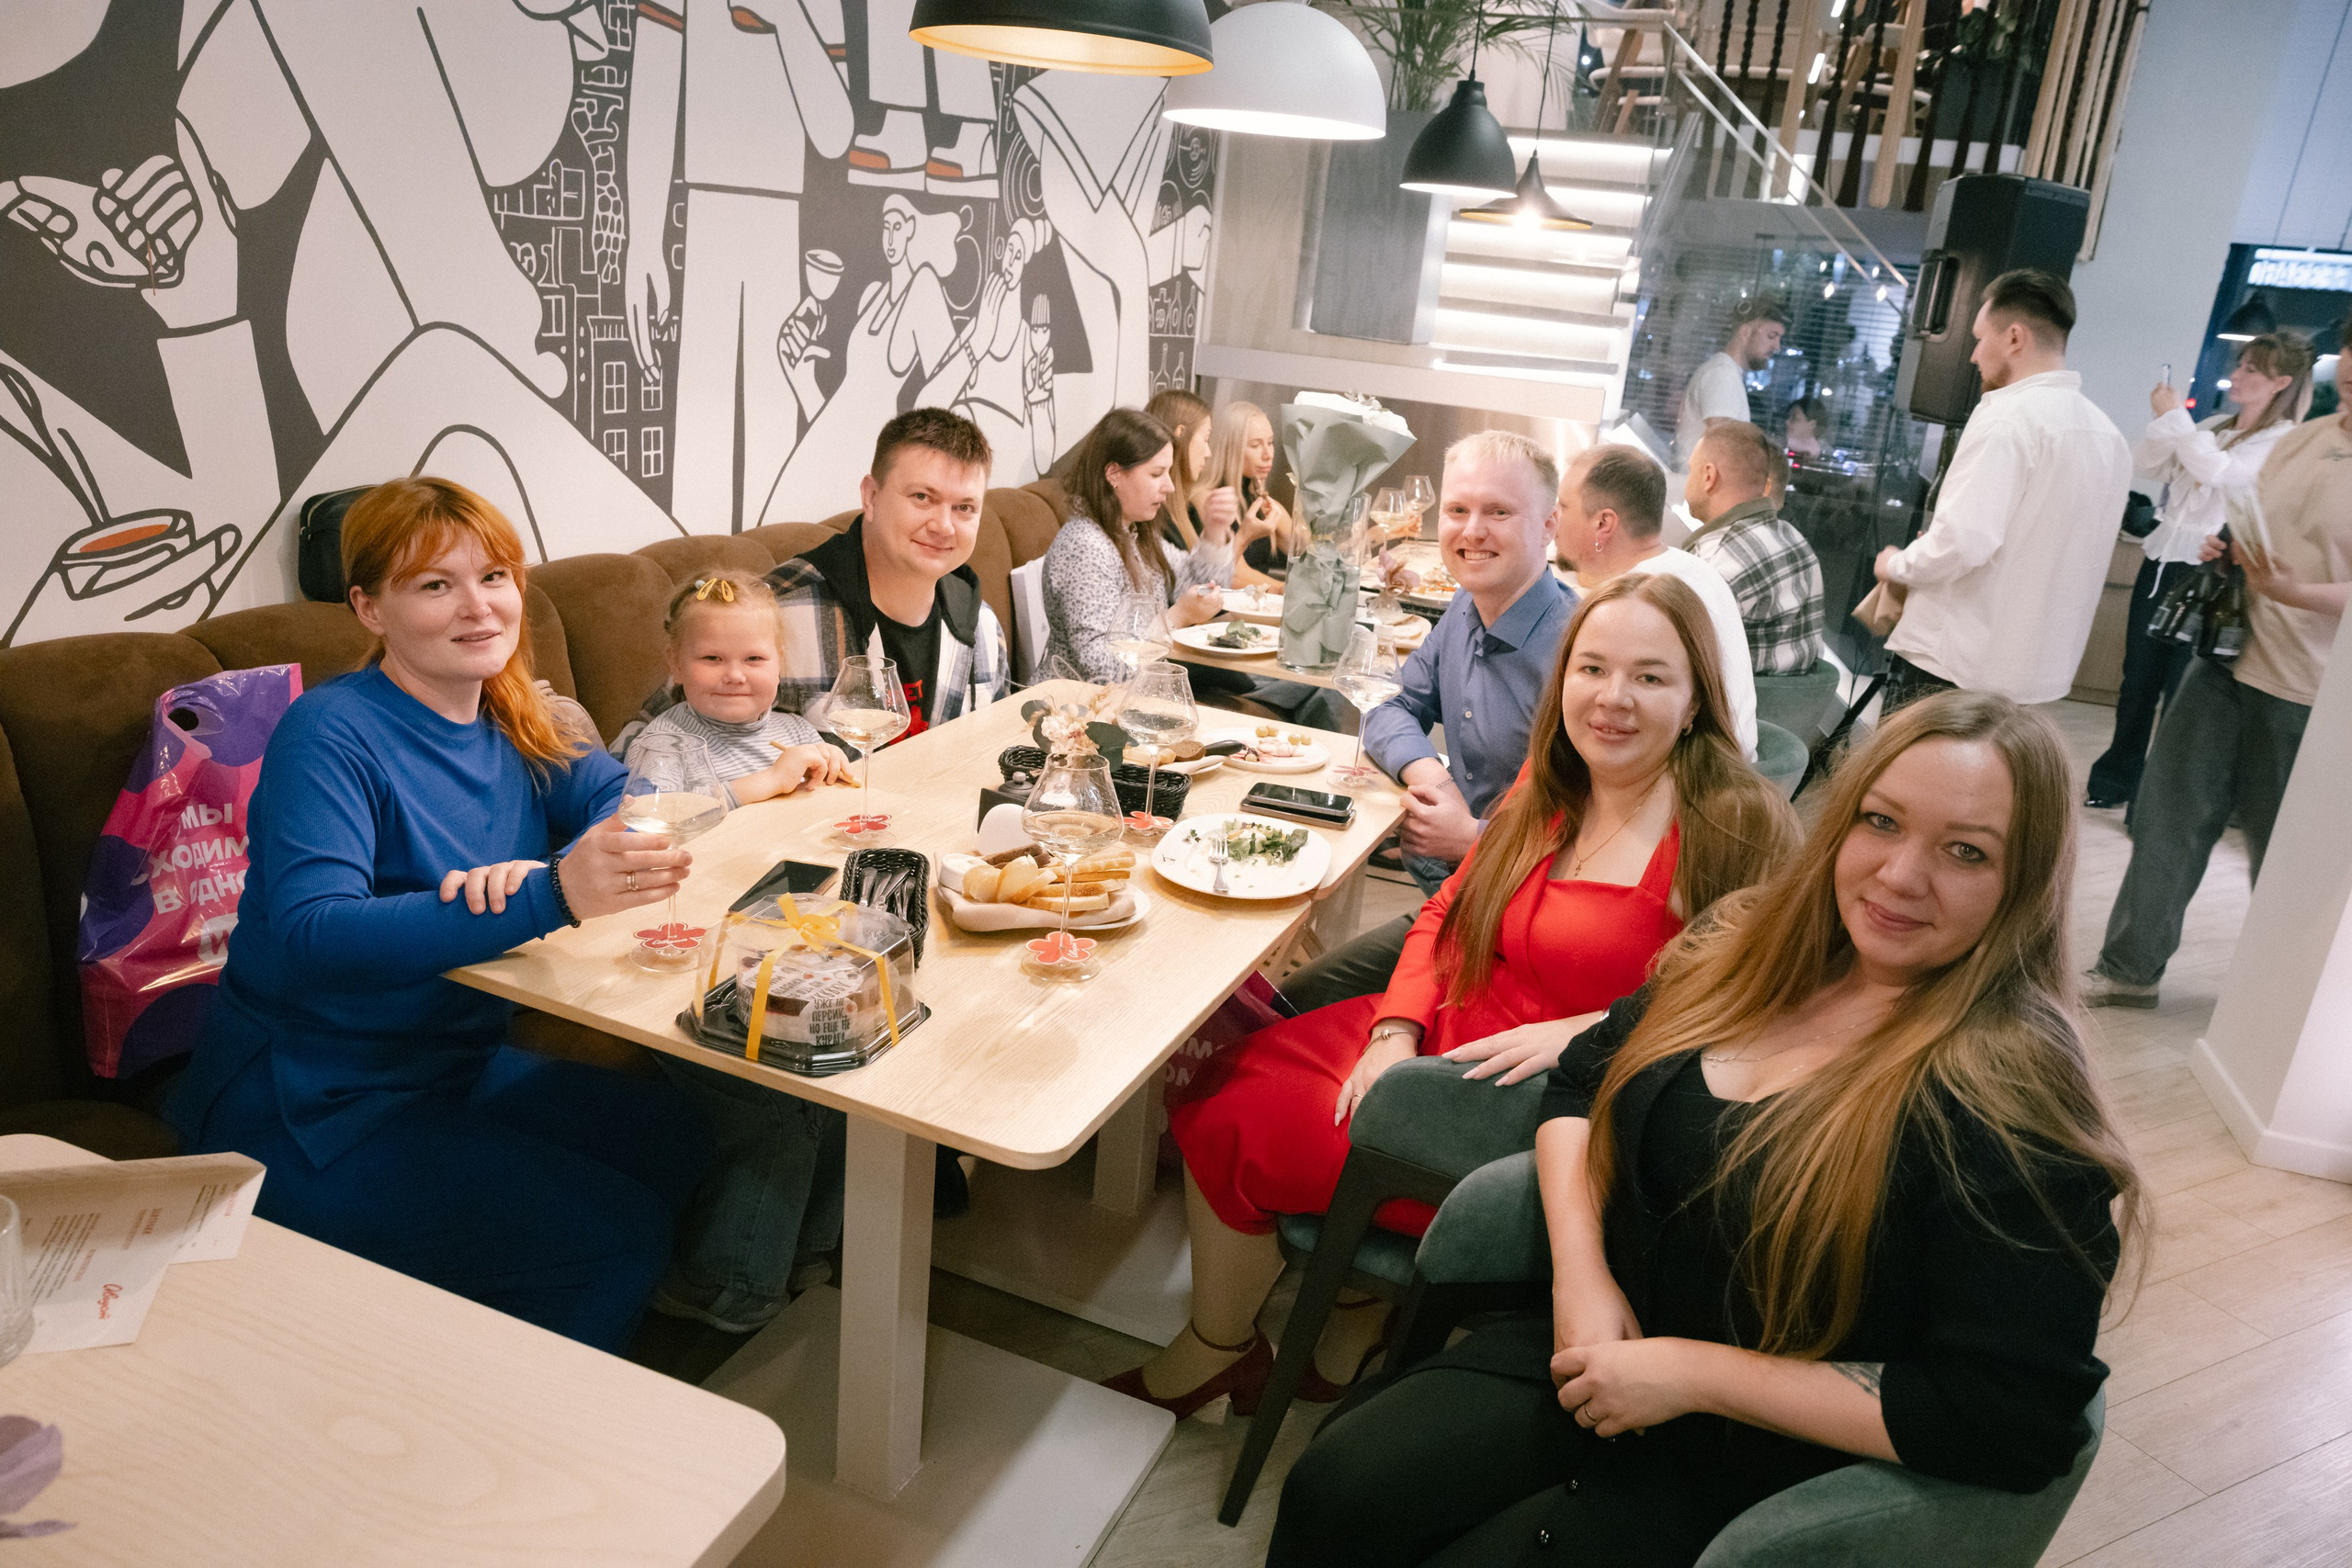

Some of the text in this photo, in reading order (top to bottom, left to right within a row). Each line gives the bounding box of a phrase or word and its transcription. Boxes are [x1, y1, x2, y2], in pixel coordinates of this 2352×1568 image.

[180, 803, 233, 829] МЫ
[153, 889, 182, 915] В
[814, 998, 844, 1010] УЖЕ НЕ
[811, 1009, 848, 1022] ПЕРСИК,
[809, 1019, 851, 1034] НО ЕЩЕ НЕ
